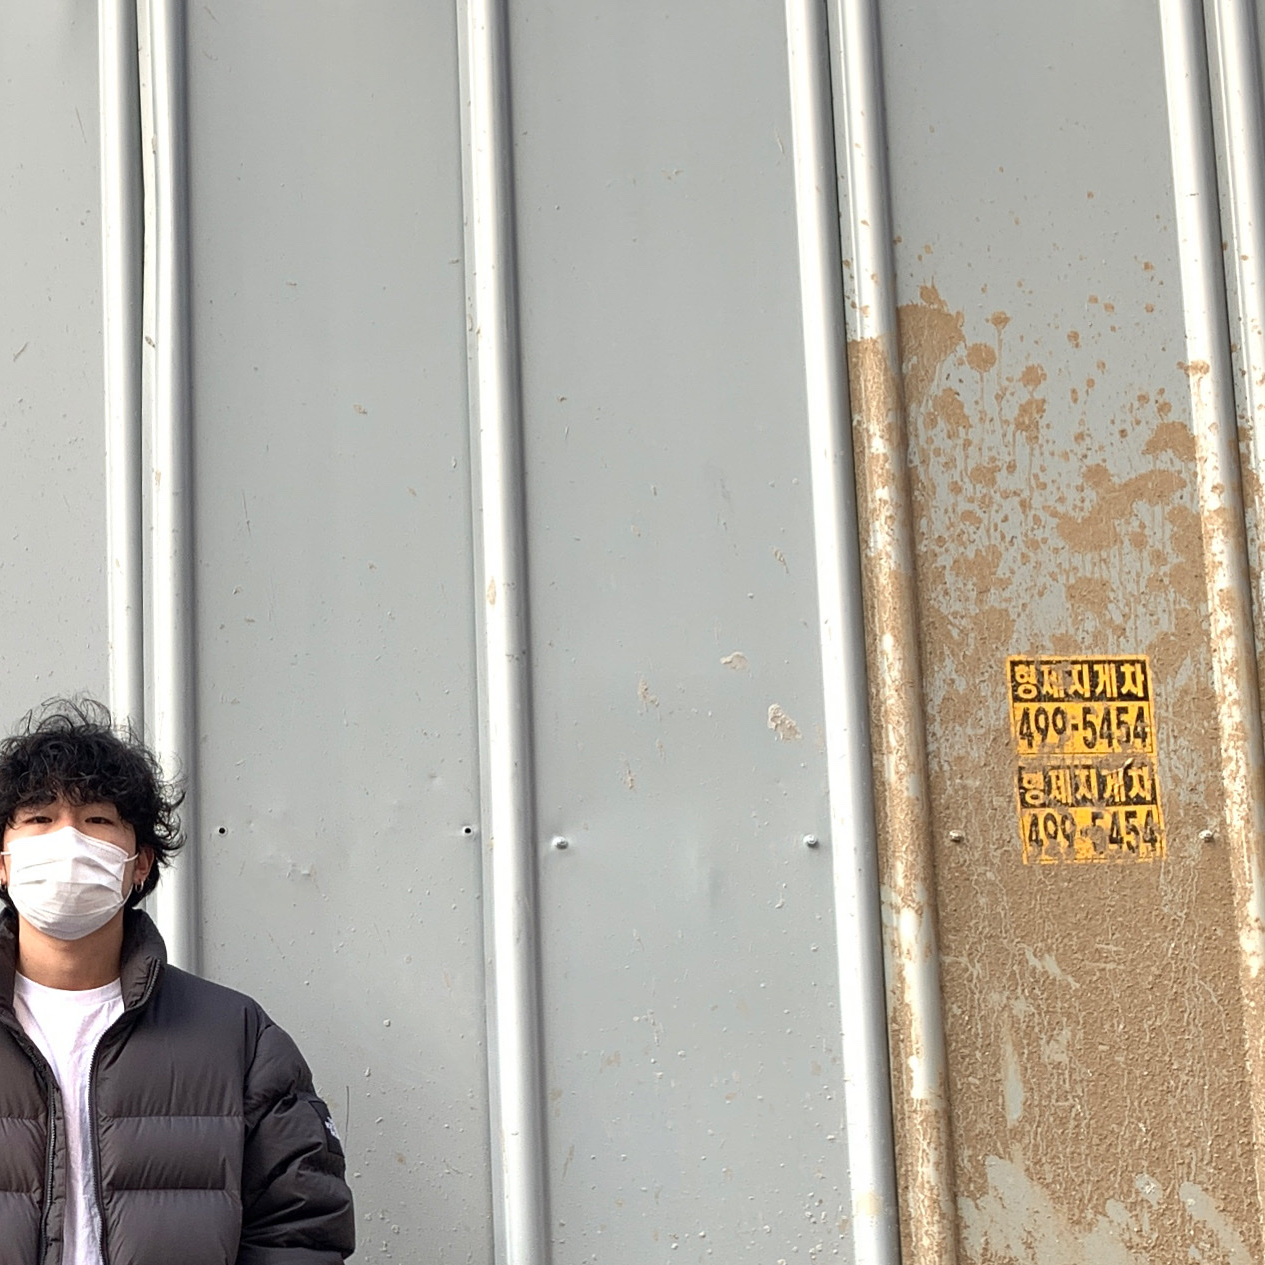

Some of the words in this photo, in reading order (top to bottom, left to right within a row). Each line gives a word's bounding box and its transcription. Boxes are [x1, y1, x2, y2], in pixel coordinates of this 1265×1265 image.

[1014, 662, 1146, 700] 형제지게차
[1019, 706, 1148, 749] 499-5454
[1022, 766, 1152, 805] 형제지게차
[1028, 809, 1158, 853] 4995454
